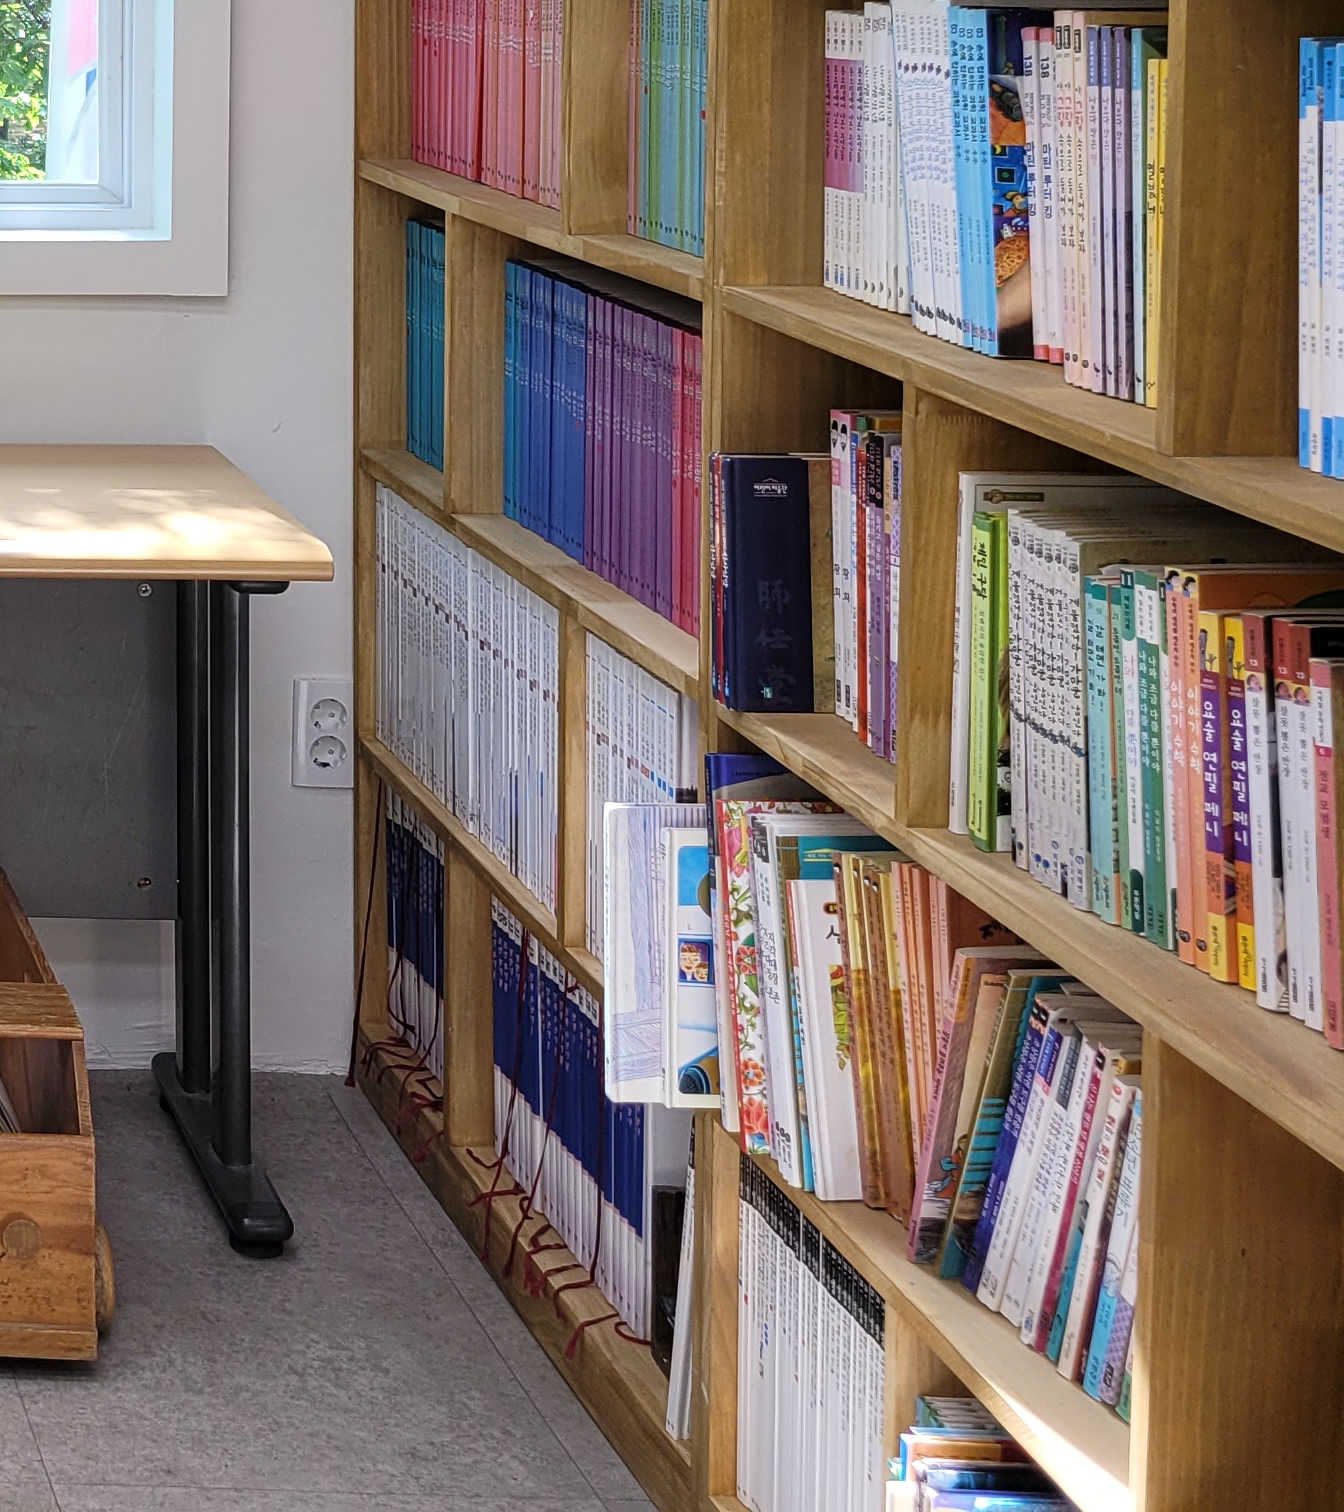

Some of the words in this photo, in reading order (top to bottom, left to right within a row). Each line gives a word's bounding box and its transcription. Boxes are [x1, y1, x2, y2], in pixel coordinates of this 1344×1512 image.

[1040, 57, 1049, 78] 138
[1024, 55, 1032, 76] 138
[1028, 202, 1036, 217] 킹
[1044, 203, 1053, 219] 킹
[1121, 573, 1133, 585] 11
[1171, 678, 1183, 728] 이야기
[1187, 685, 1199, 734] 이야기
[1202, 700, 1216, 743] 요술
[1231, 708, 1244, 751] 요술
[1204, 752, 1217, 794] 연필
[1232, 760, 1246, 803] 연필
[1204, 802, 1219, 837] 페니
[1233, 810, 1248, 846] 페니
